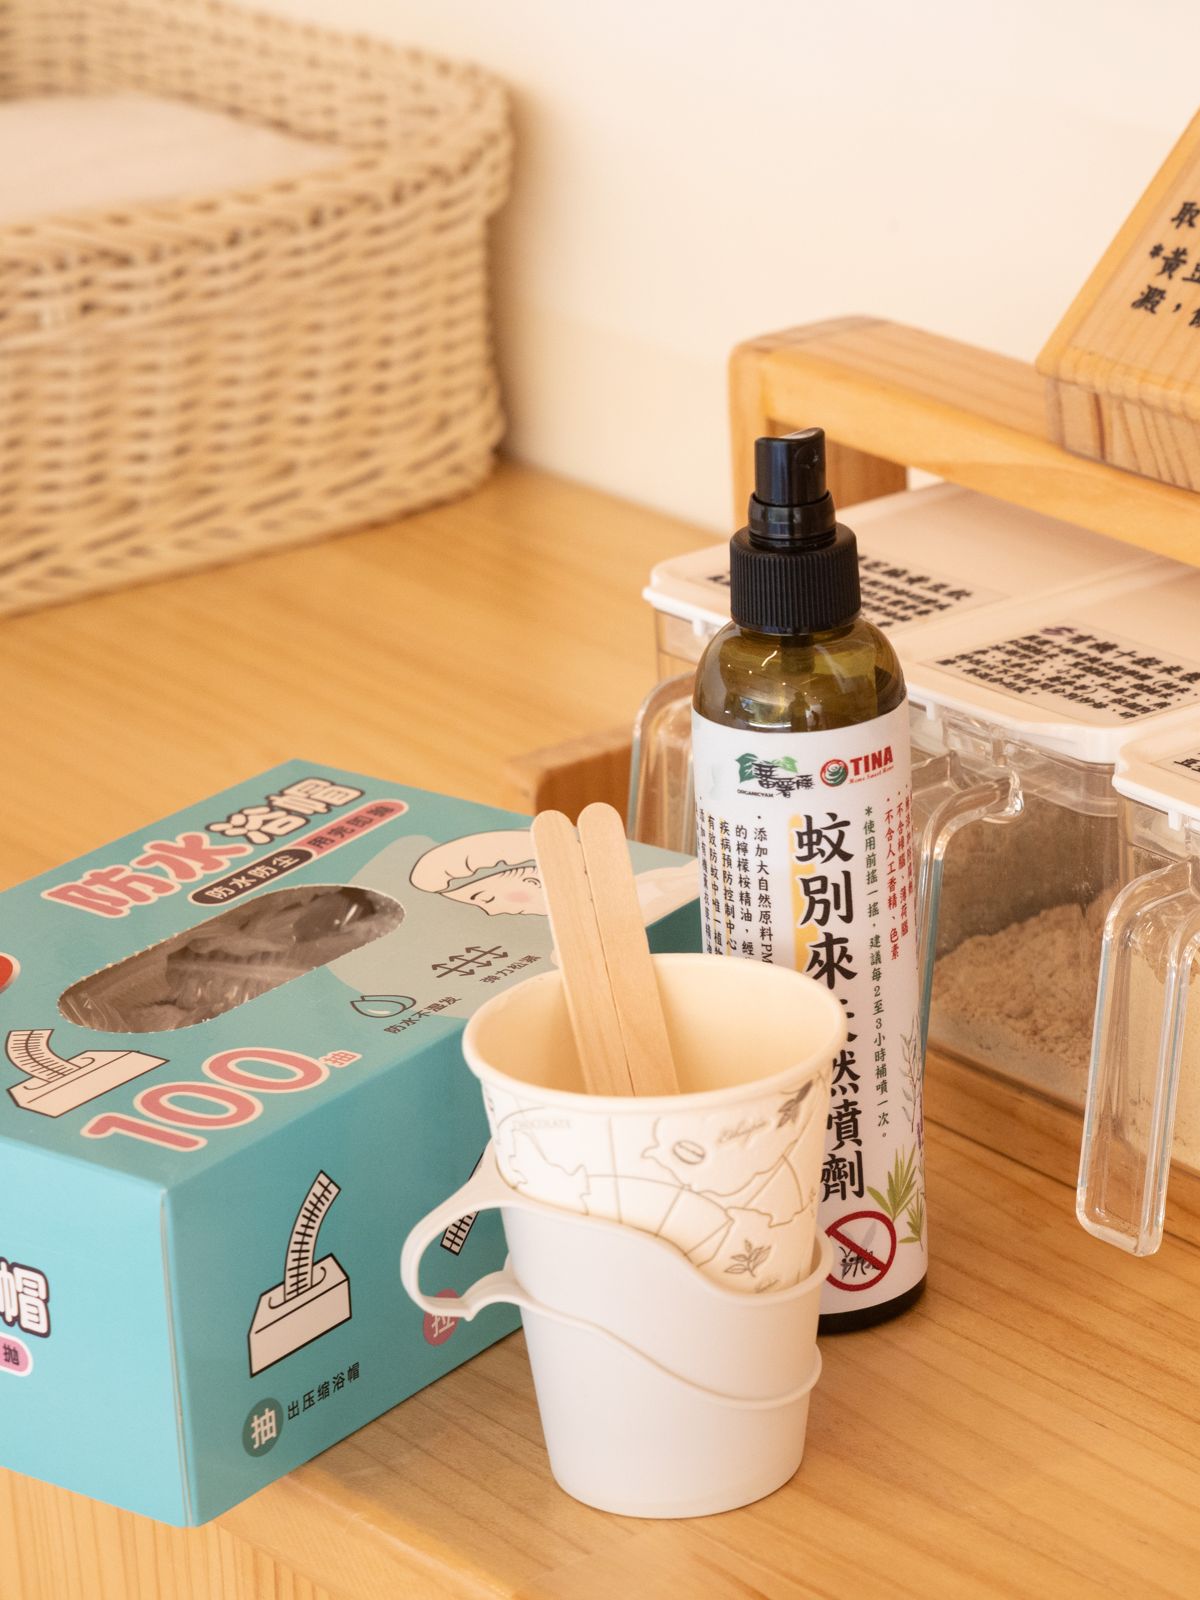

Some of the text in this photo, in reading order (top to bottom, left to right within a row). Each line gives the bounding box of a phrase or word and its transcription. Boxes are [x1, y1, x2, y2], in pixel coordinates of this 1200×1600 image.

[850, 745, 893, 776] TINA
[41, 776, 366, 919] 防水浴帽
[203, 852, 302, 903] 防水防尘
[735, 824, 755, 958] 的檸檬桉精油，經
[249, 1361, 361, 1451] 抽 出压缩浴帽
